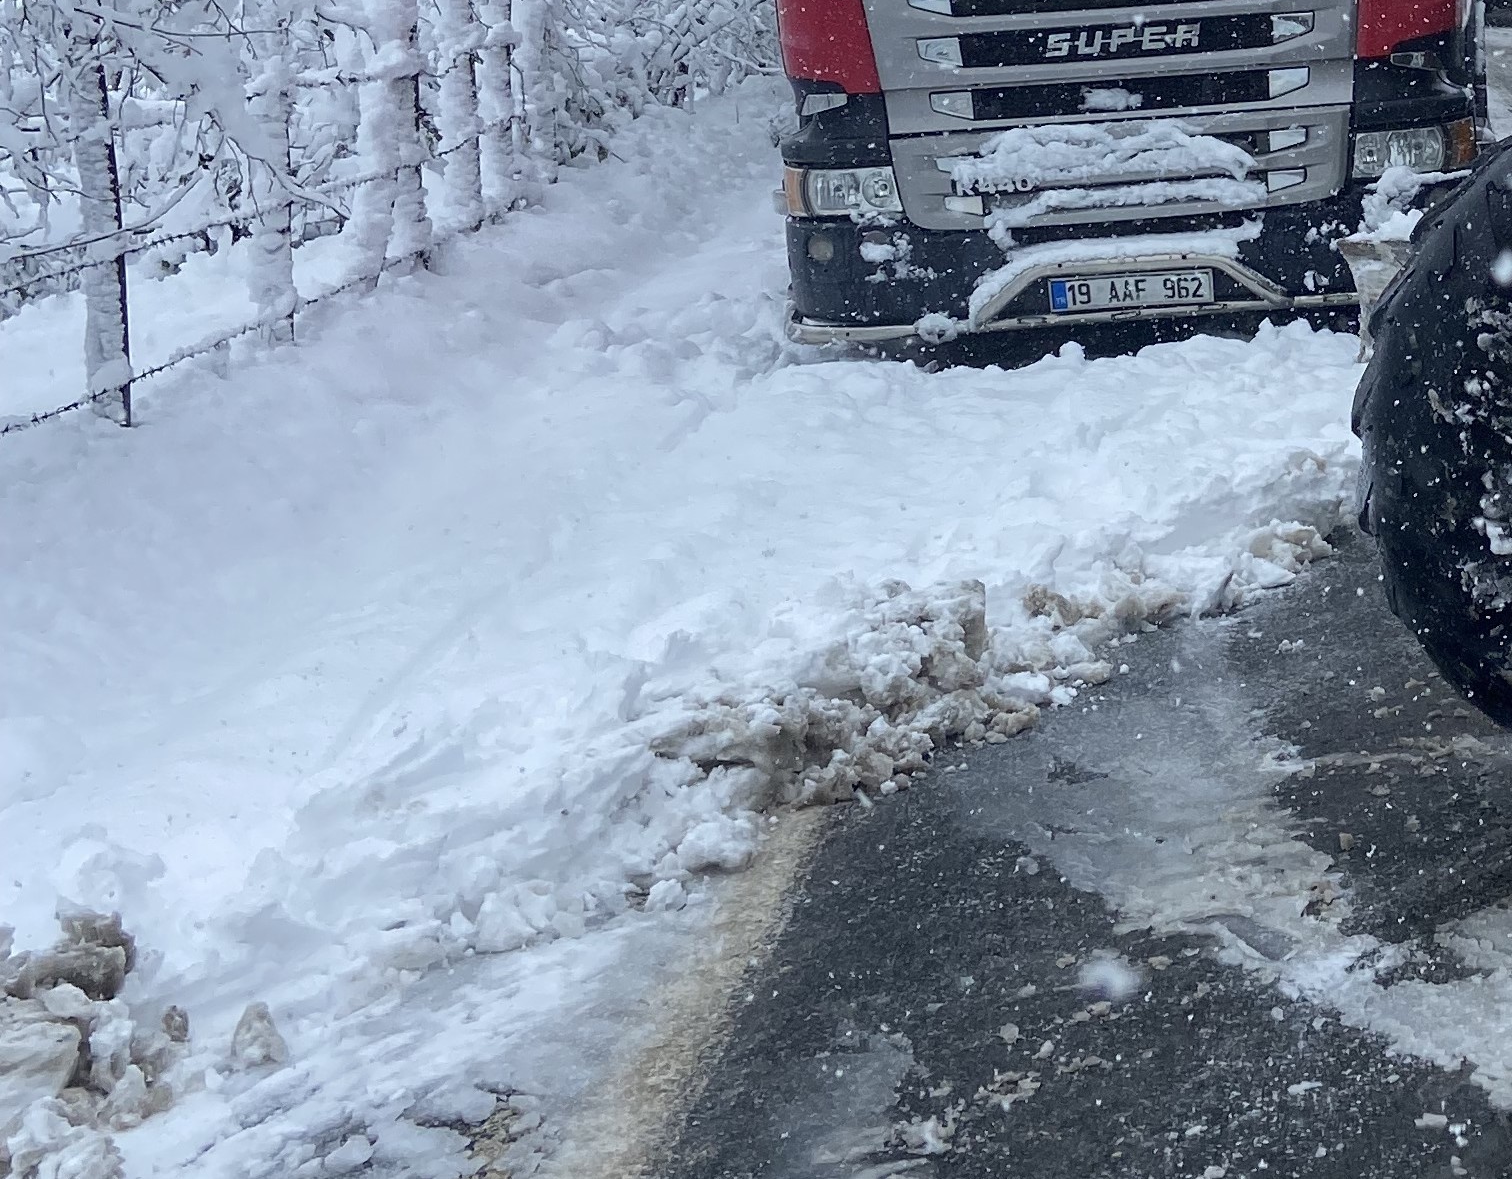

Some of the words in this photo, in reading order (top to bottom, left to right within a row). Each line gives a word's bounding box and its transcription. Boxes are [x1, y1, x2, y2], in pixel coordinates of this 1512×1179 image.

[1045, 23, 1200, 58] SUPER
[1067, 282, 1091, 306] 19
[1108, 279, 1147, 304] AAF
[1163, 277, 1204, 299] 962
